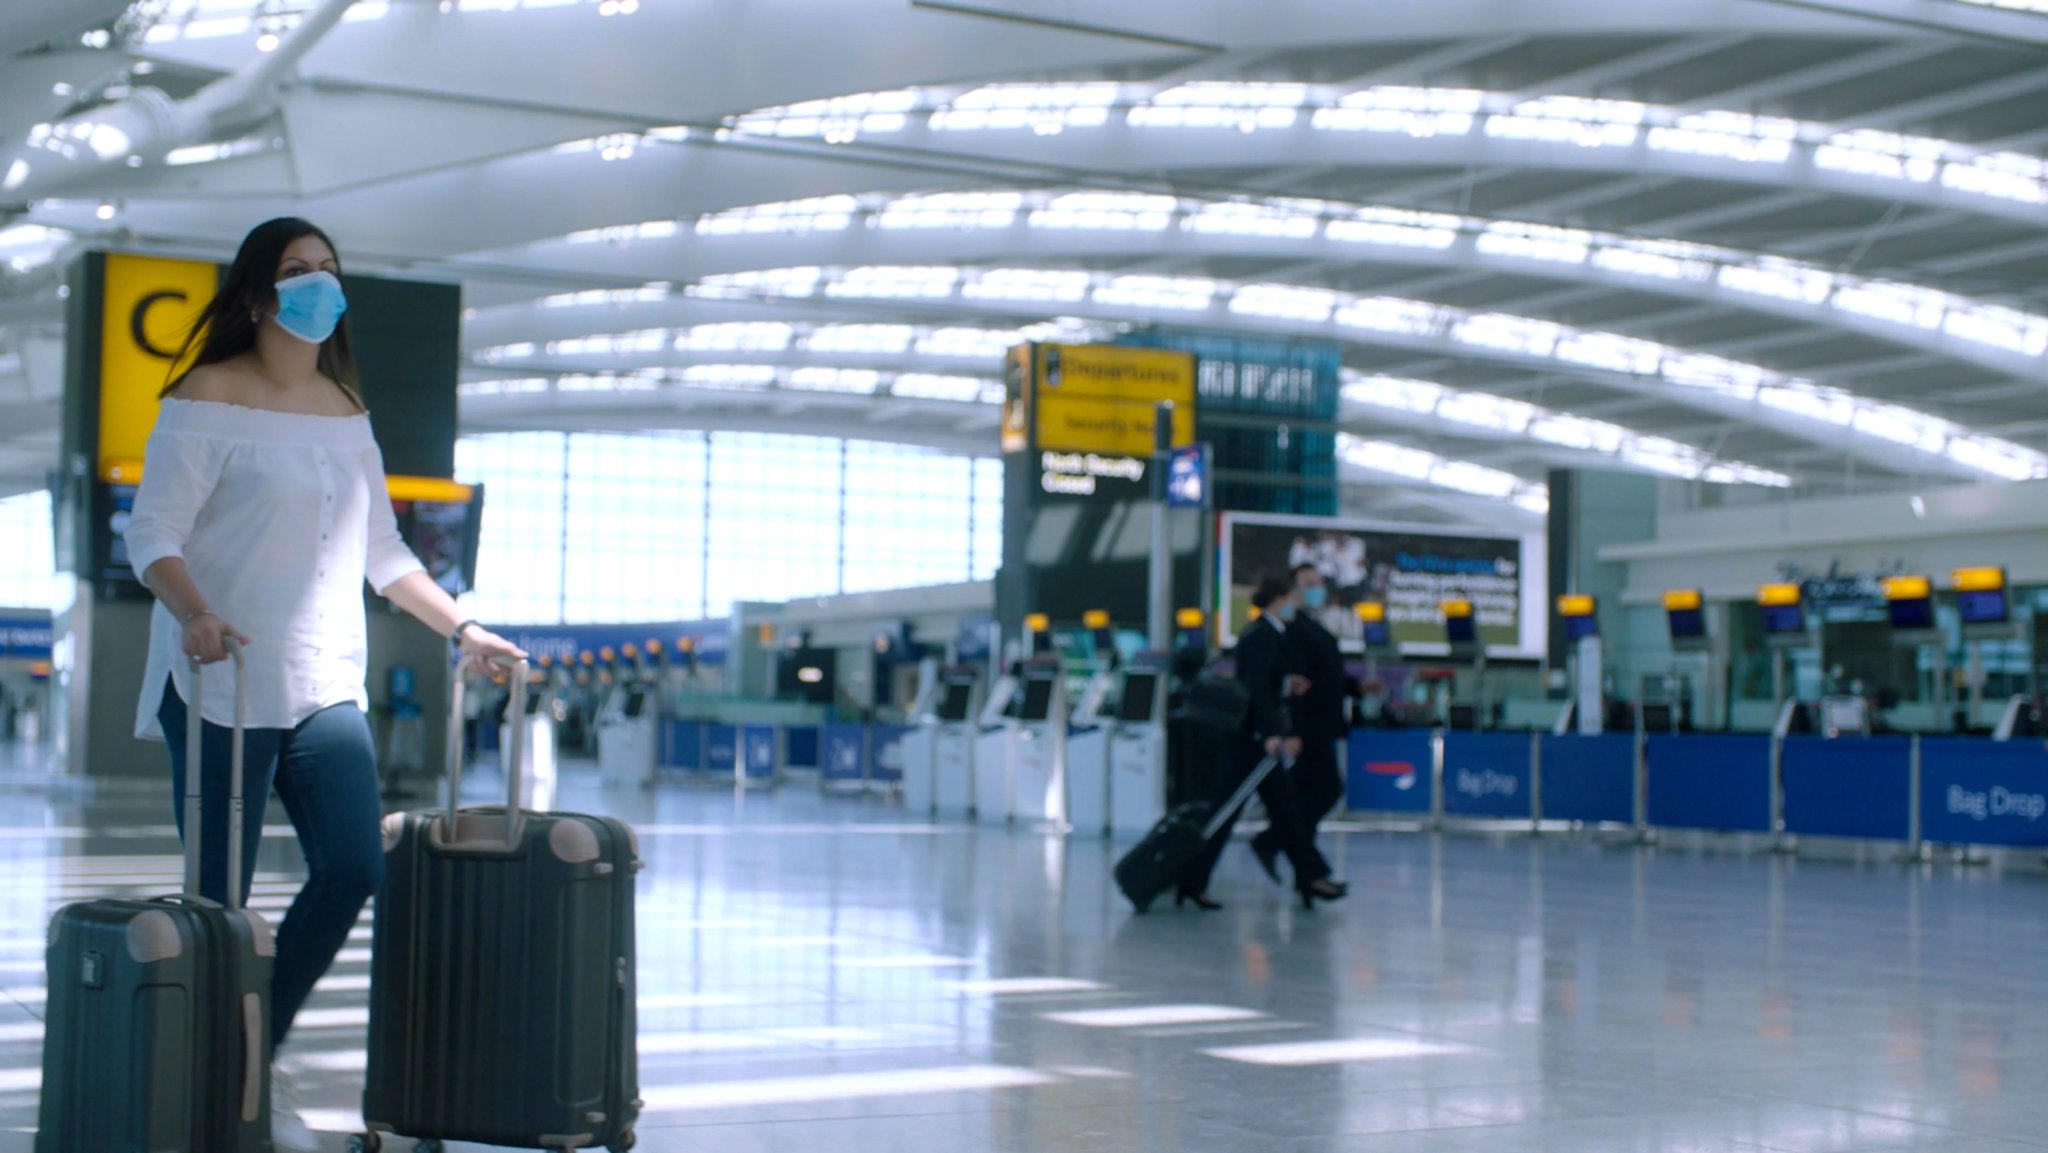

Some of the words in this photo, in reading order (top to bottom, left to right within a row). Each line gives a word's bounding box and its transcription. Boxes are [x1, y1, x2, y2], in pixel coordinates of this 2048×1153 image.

[130, 289, 188, 360] C
[1063, 355, 1181, 385] Departures
[1065, 414, 1128, 436] Security
[1084, 453, 1145, 482] Security
[1457, 768, 1482, 798] Bag
[1483, 768, 1518, 797] Drop
[1947, 784, 1987, 821] Bag
[1989, 785, 2046, 822] Drop
